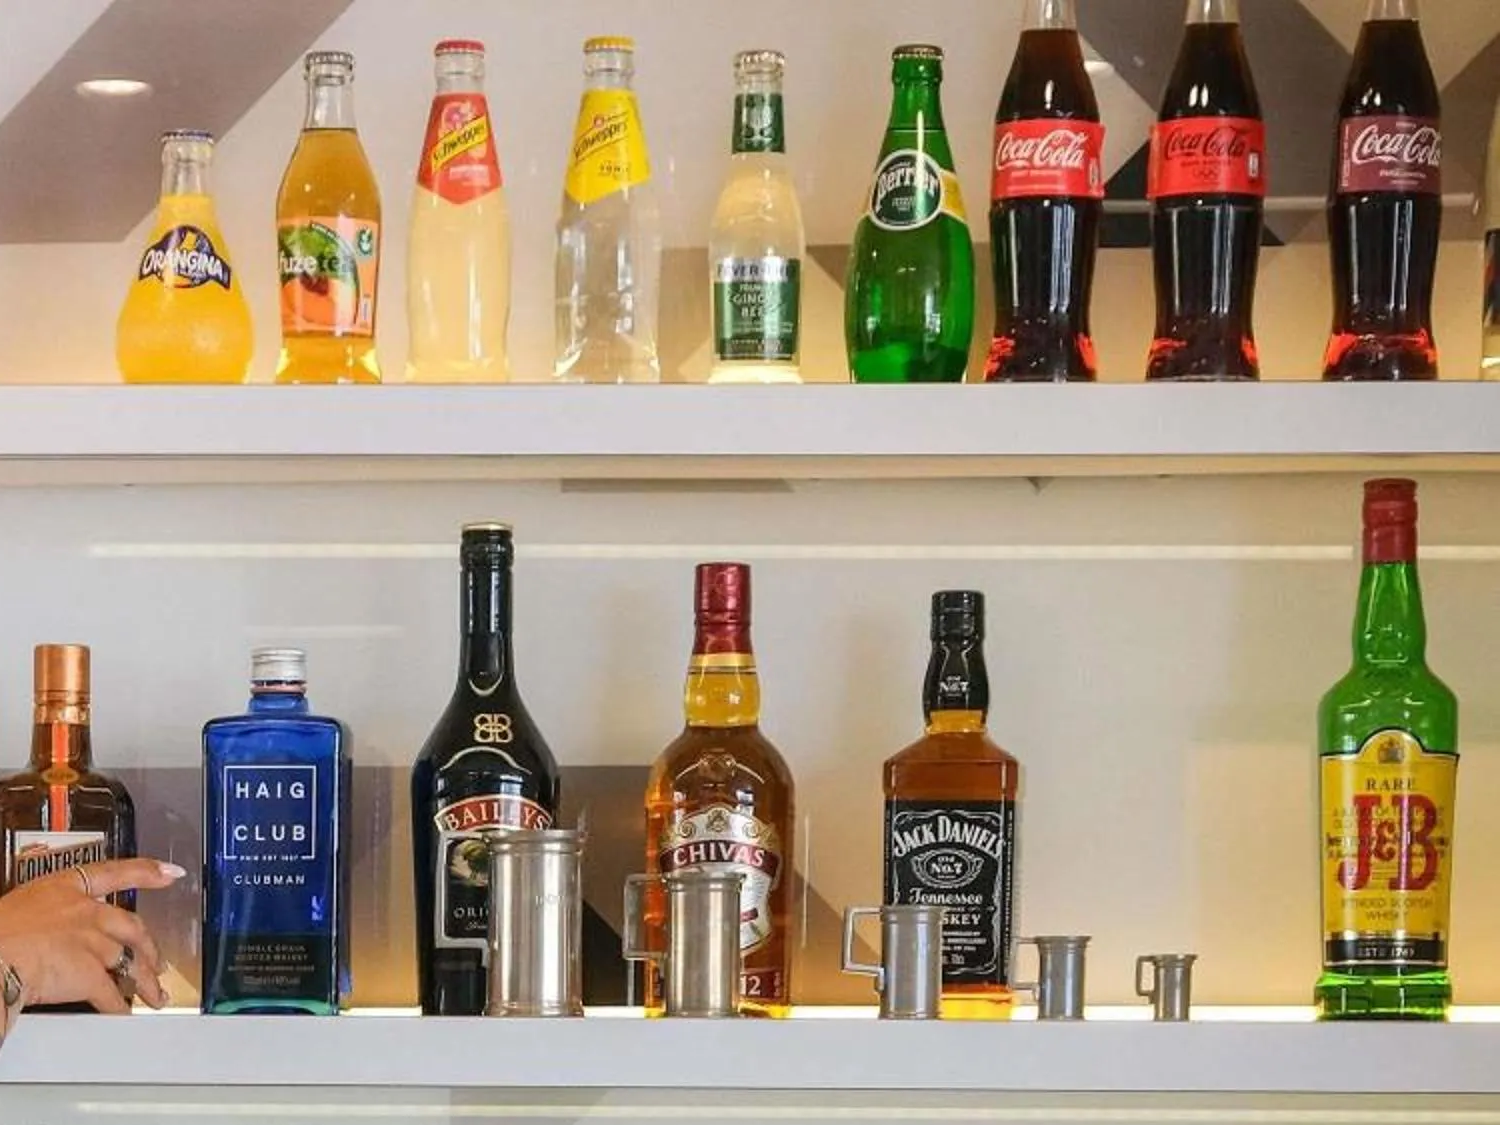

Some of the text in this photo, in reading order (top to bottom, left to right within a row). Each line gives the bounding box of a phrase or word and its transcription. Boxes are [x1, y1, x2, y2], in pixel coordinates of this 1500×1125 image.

[235, 781, 306, 799] HAIG
[445, 801, 545, 831] BAILYS
[233, 824, 307, 843] CLUB
[893, 823, 936, 858] JACK
[673, 842, 766, 868] CHIVAS
[233, 874, 306, 886] CLUBMAN
[909, 886, 984, 906] Tennessee
